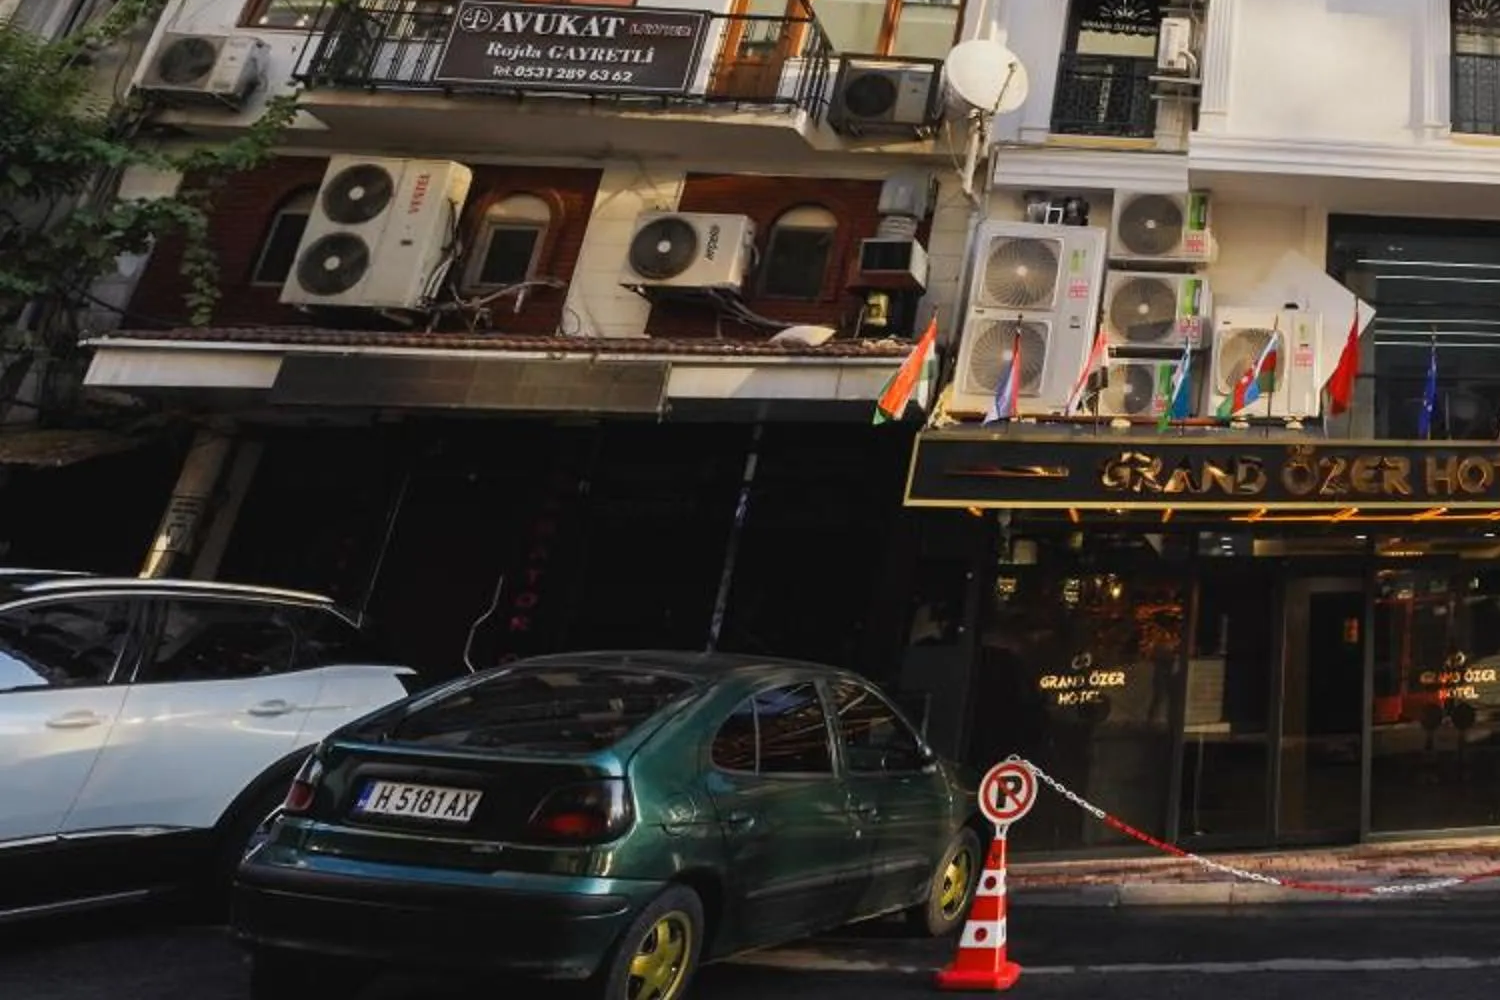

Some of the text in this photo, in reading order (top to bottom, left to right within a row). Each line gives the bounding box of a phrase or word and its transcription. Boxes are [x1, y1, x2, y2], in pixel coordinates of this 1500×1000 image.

[492, 10, 625, 38] AVUKAT
[486, 41, 655, 64] Rojda GAYRETLİ
[514, 65, 552, 78] 0531
[555, 67, 586, 80] 289
[589, 69, 612, 81] 63
[612, 70, 633, 82] 62
[1101, 449, 1267, 495] GRAND
[1281, 444, 1411, 496] ÖZER
[374, 785, 478, 818] H 5181 AX
